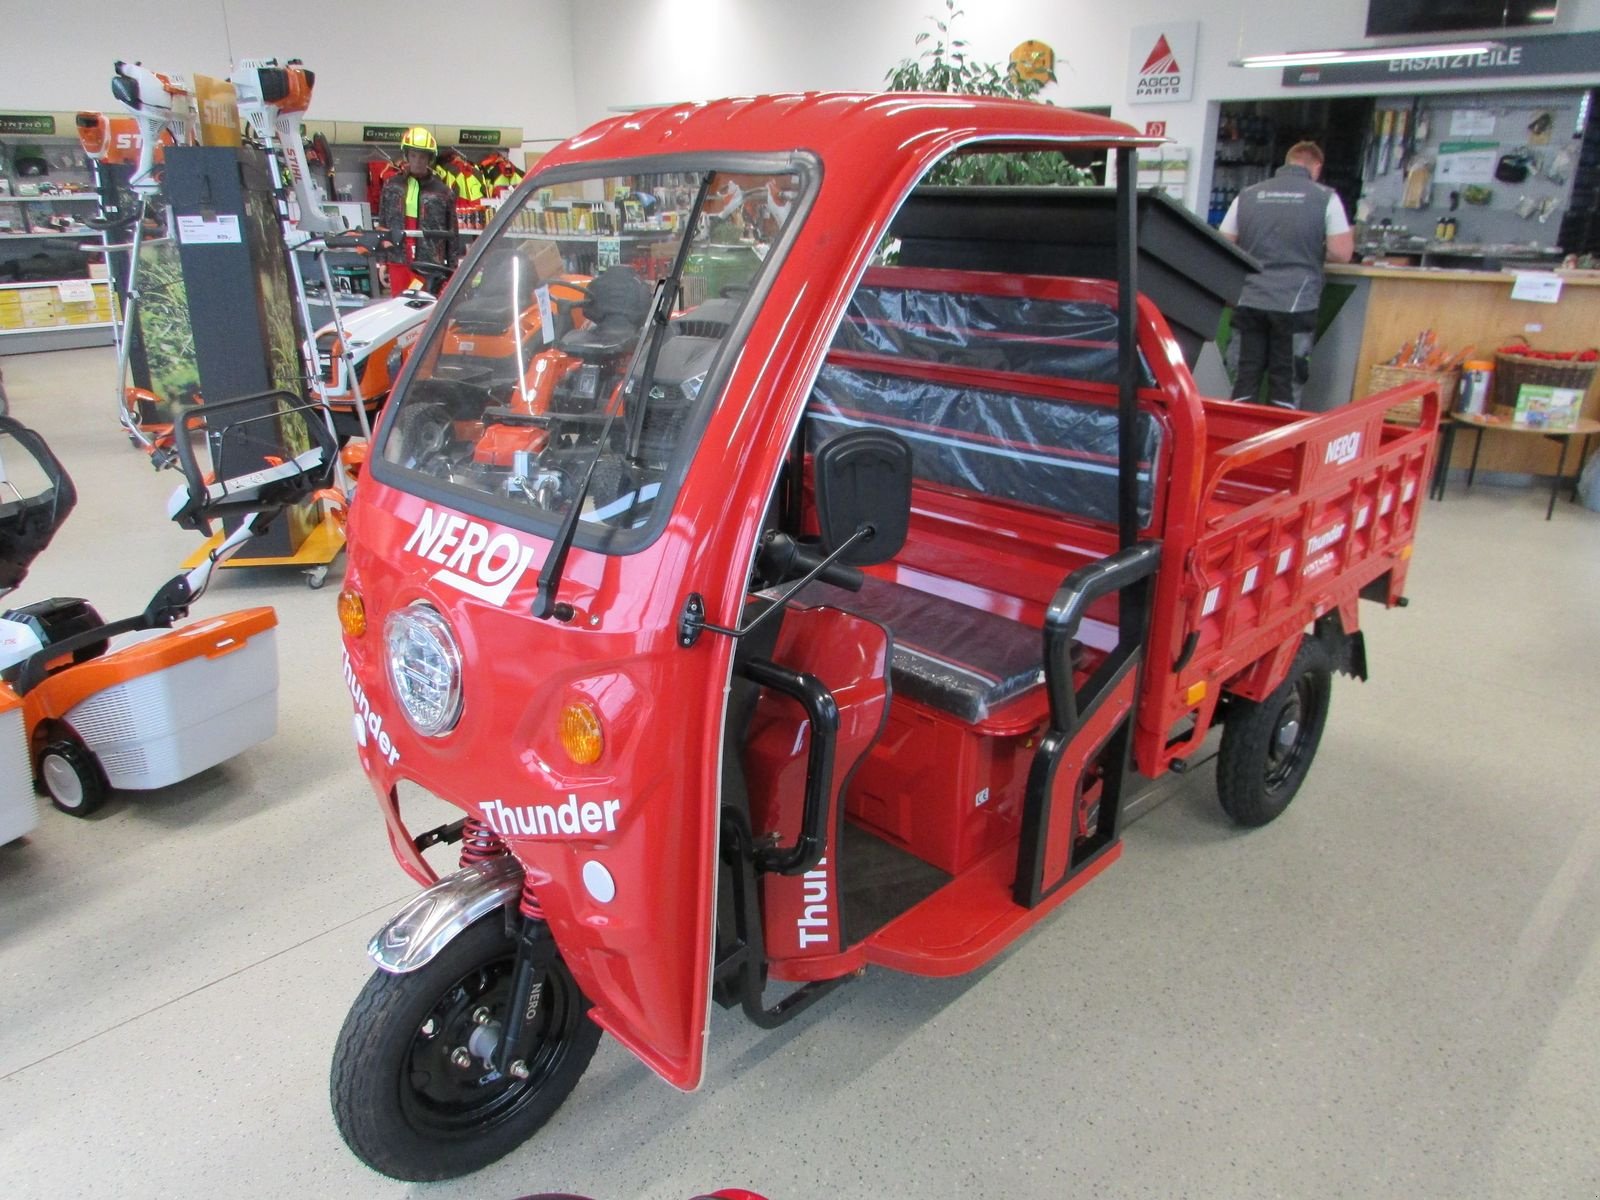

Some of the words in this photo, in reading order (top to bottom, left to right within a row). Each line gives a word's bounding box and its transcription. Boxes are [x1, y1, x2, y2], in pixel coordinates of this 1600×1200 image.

[1388, 47, 1523, 73] ERSATZTEILE
[1136, 86, 1180, 96] PARTS
[1137, 76, 1181, 89] AGCO
[203, 100, 236, 129] STIHL
[286, 147, 302, 184] STIHL
[1325, 432, 1359, 465] NERO
[404, 507, 522, 584] NERO
[1307, 523, 1346, 557] Thunder
[479, 794, 621, 835] Thunder
[797, 844, 829, 949] Thun
[526, 982, 543, 1020] NERO
